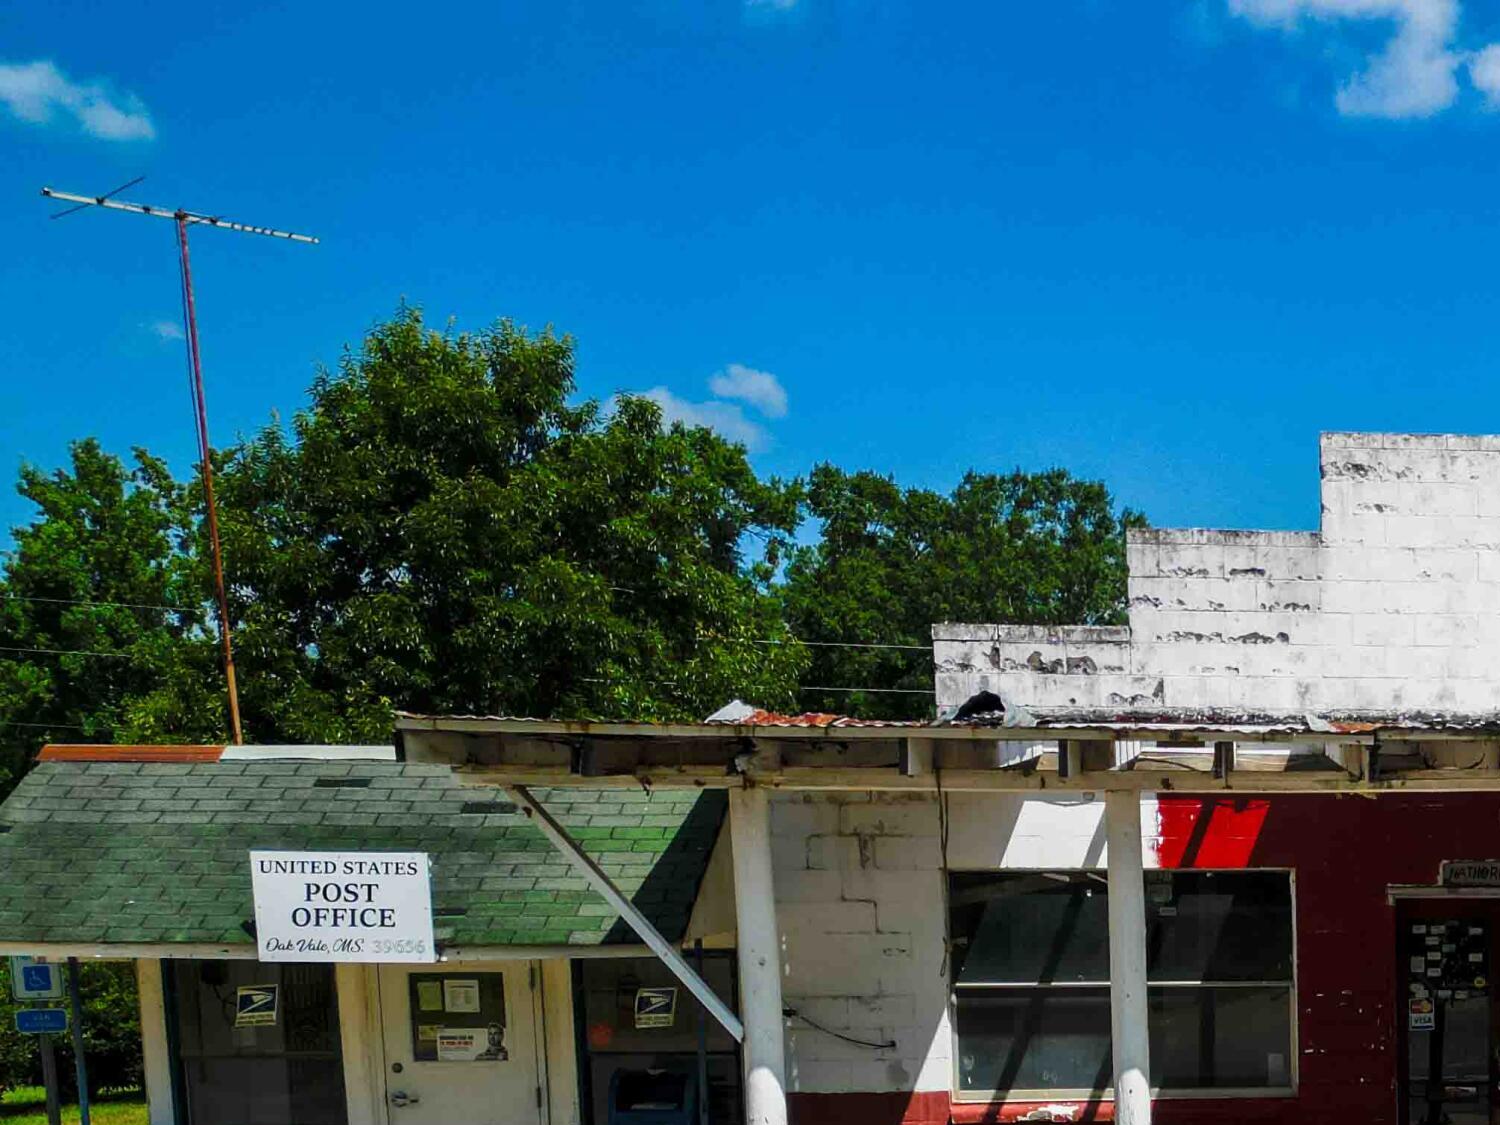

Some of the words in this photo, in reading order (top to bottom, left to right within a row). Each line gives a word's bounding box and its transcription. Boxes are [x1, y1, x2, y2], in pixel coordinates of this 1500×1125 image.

[259, 860, 337, 875] UNITED
[343, 861, 418, 876] STATES
[305, 882, 379, 903] POST
[292, 907, 396, 928] OFFICE
[266, 937, 294, 953] Oak
